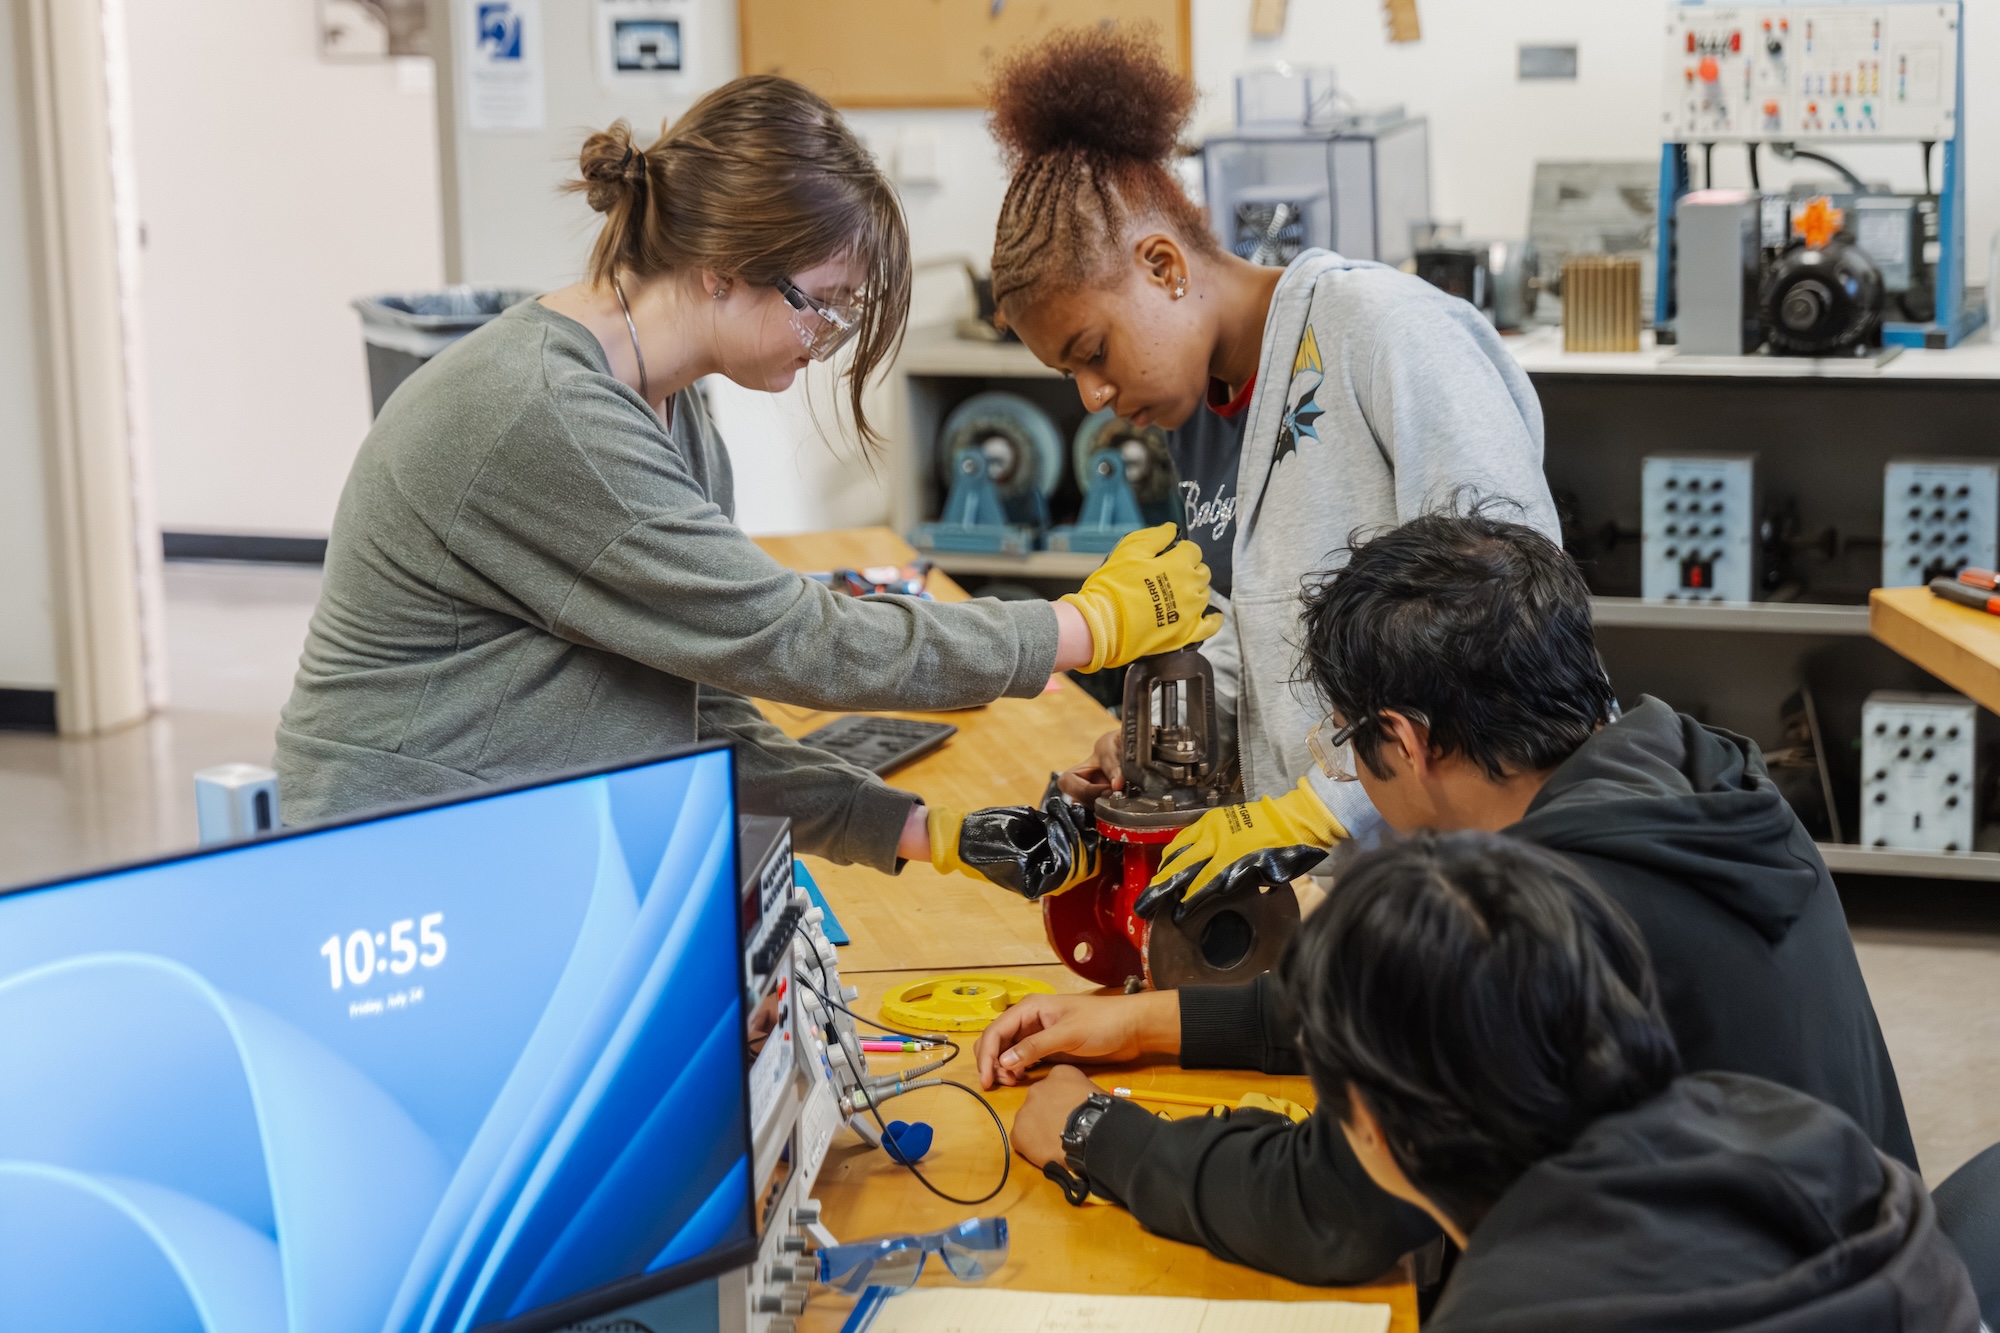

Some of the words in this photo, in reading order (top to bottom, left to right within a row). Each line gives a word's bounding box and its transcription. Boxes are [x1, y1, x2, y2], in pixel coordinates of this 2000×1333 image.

[1178, 480, 1236, 541] Baby
[1144, 578, 1161, 602] GRIP
[1154, 603, 1165, 628] FIRM
[1239, 809, 1253, 828] GRIP
[320, 912, 447, 990] 10:55
